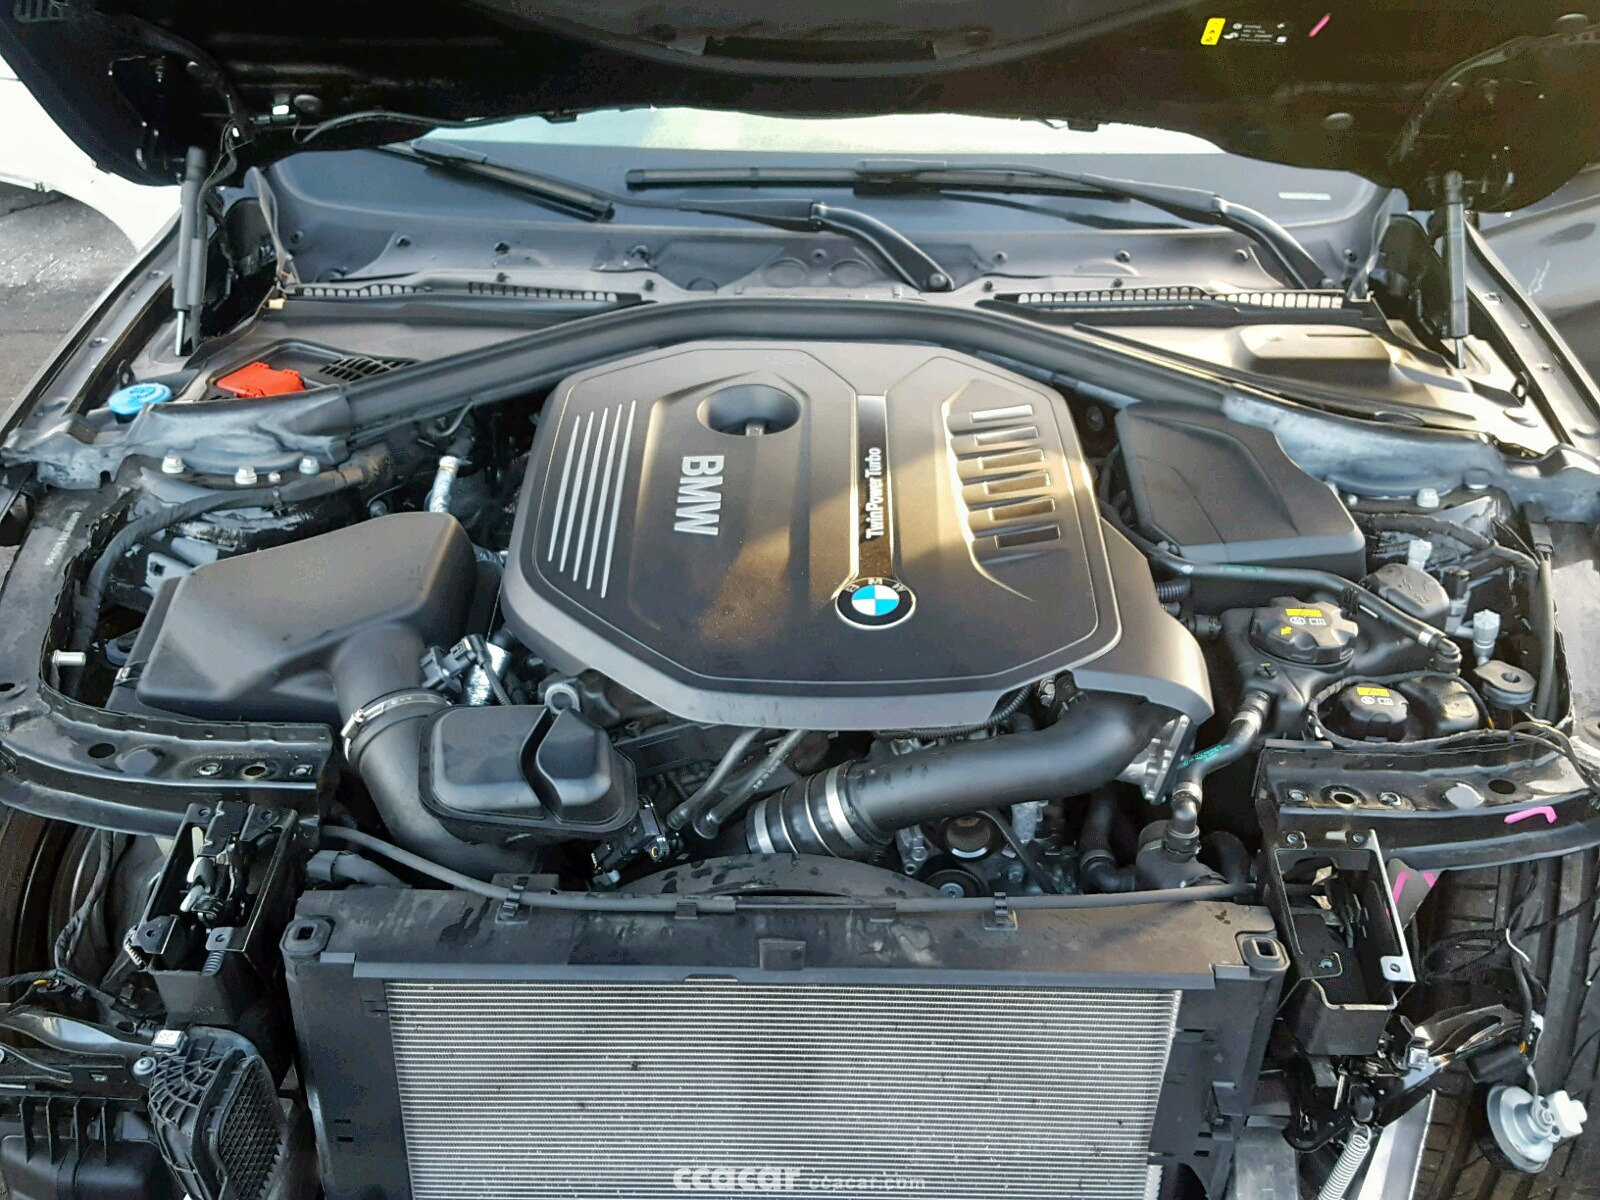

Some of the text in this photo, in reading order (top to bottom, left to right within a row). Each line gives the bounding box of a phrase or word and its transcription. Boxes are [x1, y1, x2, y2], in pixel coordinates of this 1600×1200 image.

[674, 455, 725, 536] BMW
[864, 447, 884, 539] TwinPower Turbo
